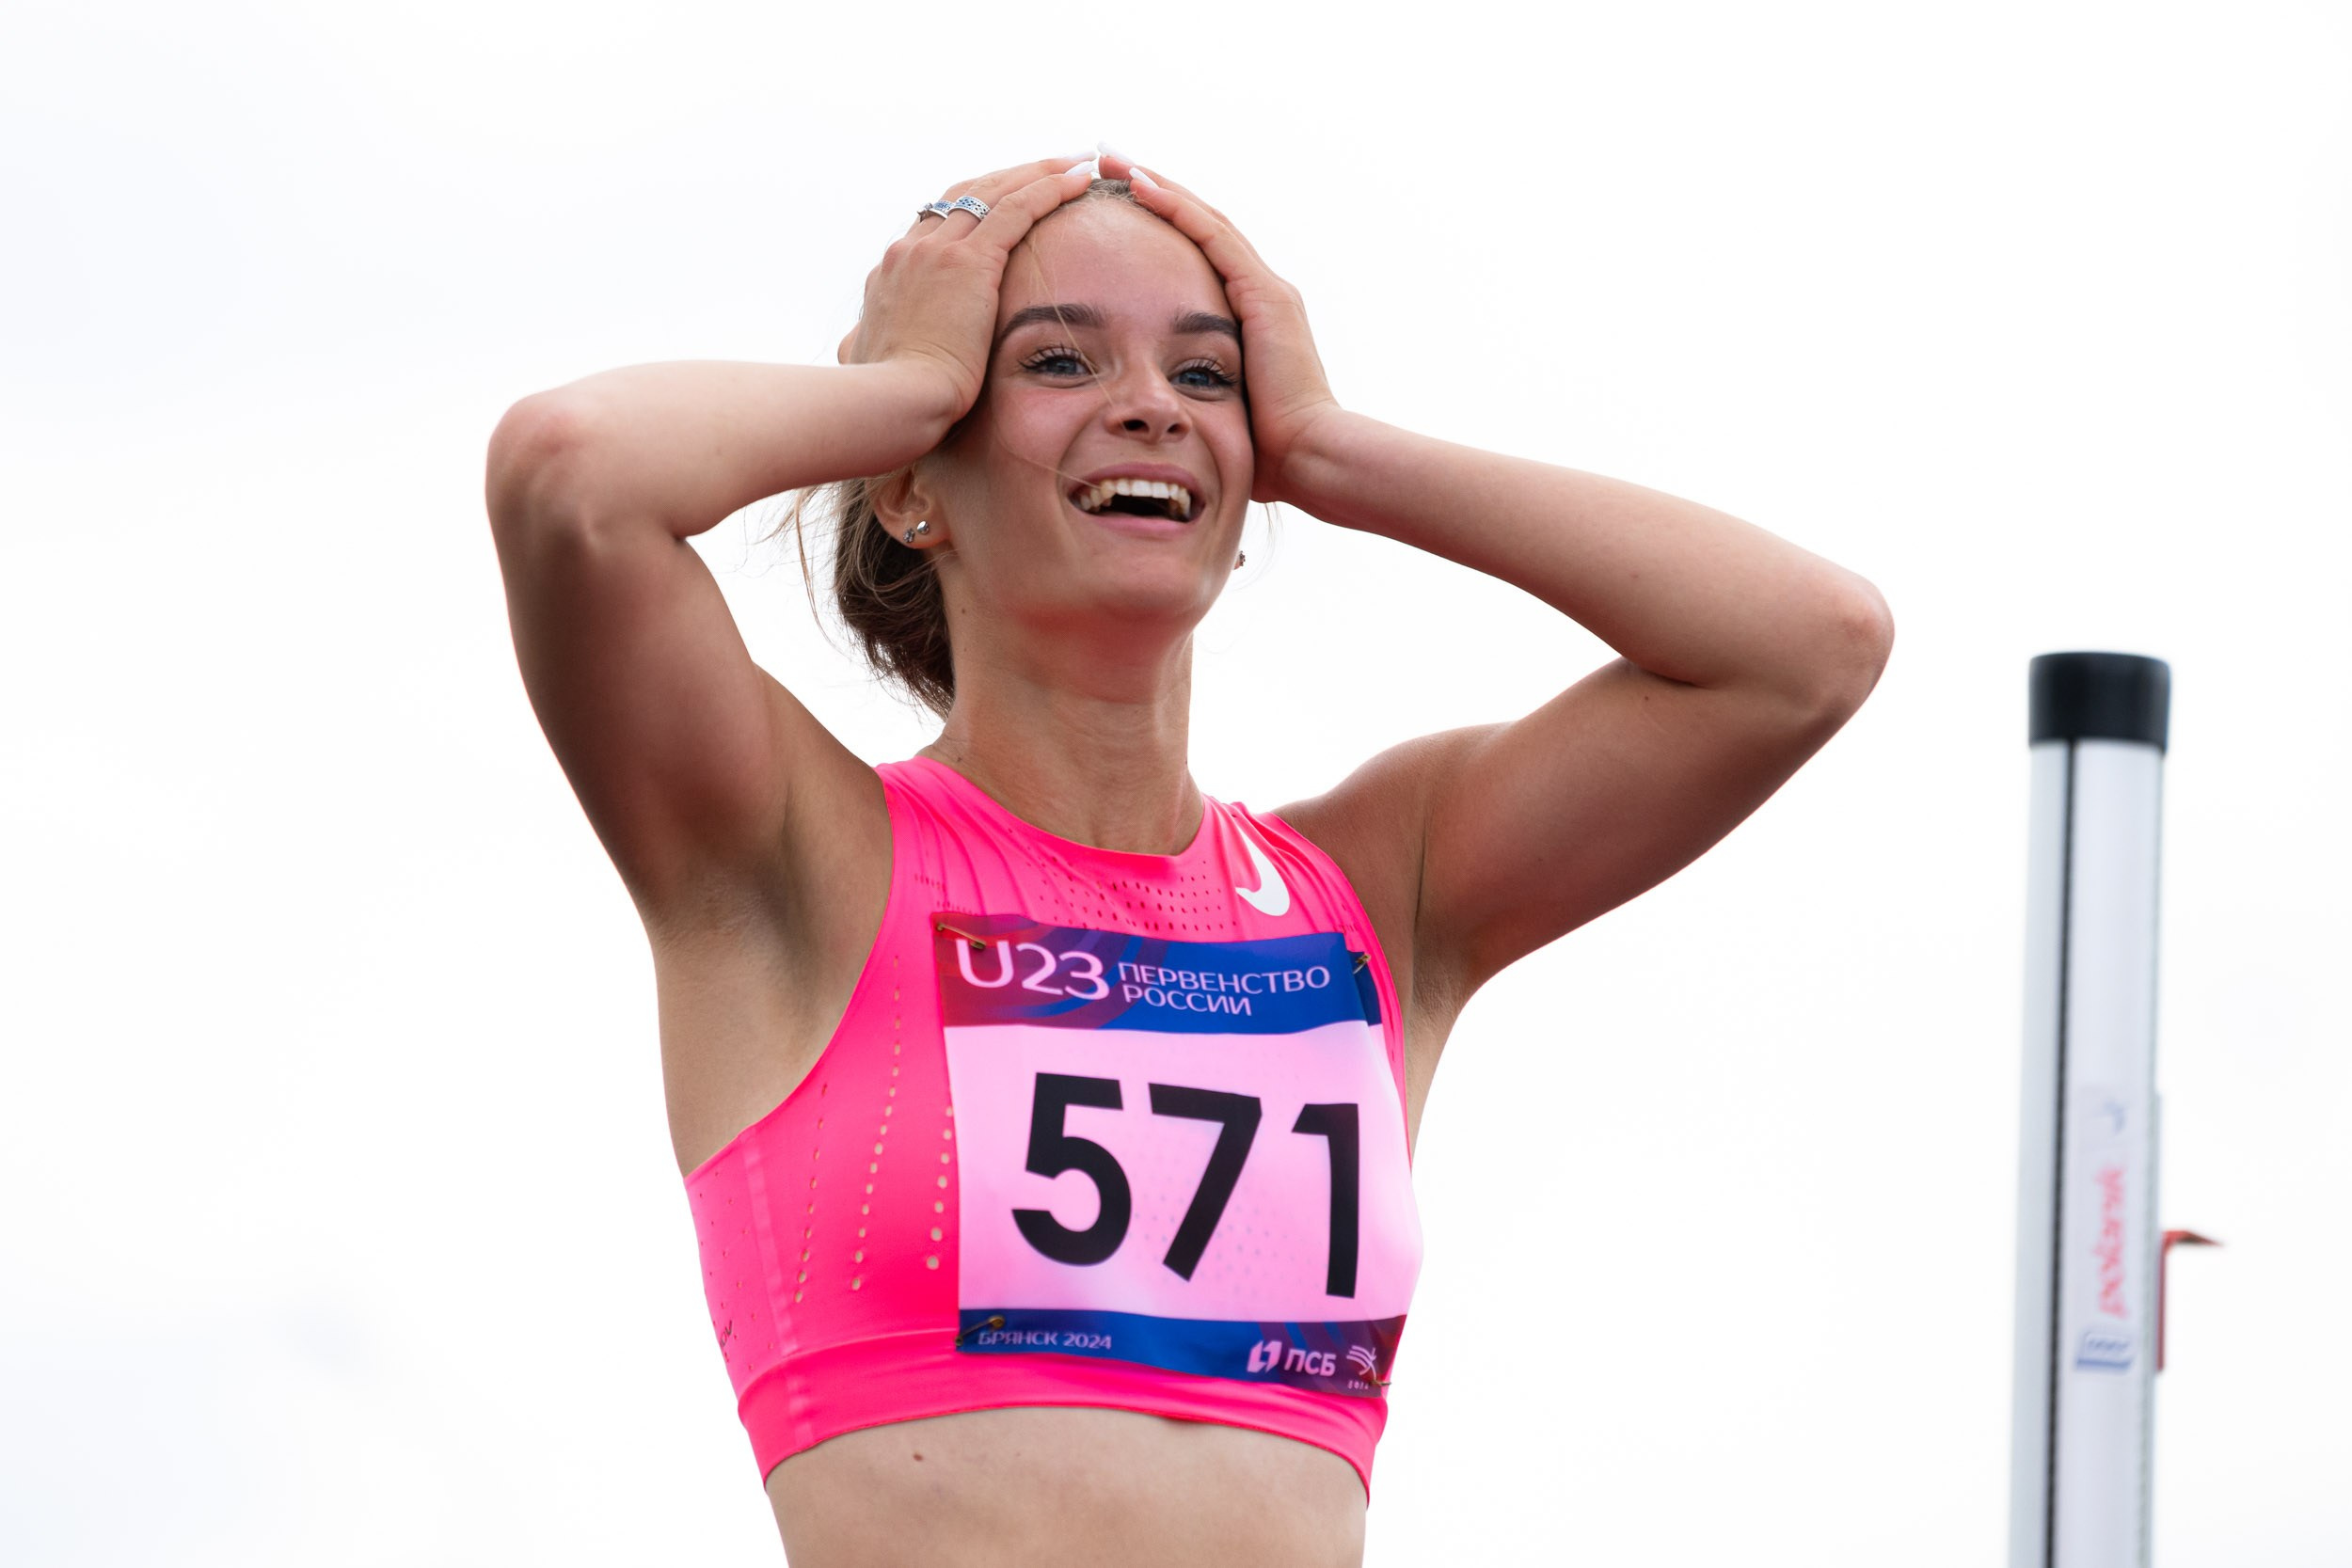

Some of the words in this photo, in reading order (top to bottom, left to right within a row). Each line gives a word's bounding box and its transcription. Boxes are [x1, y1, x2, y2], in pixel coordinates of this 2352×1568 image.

[955, 938, 1110, 1001] U23
[1118, 961, 1331, 995] ПЕРВЕНСТВО
[1122, 984, 1252, 1017] РОССИИ
[1011, 1072, 1359, 1299] 571
[977, 1330, 1058, 1347] БРЯНСК
[1063, 1331, 1113, 1351] 2024
[1283, 1348, 1337, 1377] ПСБ
